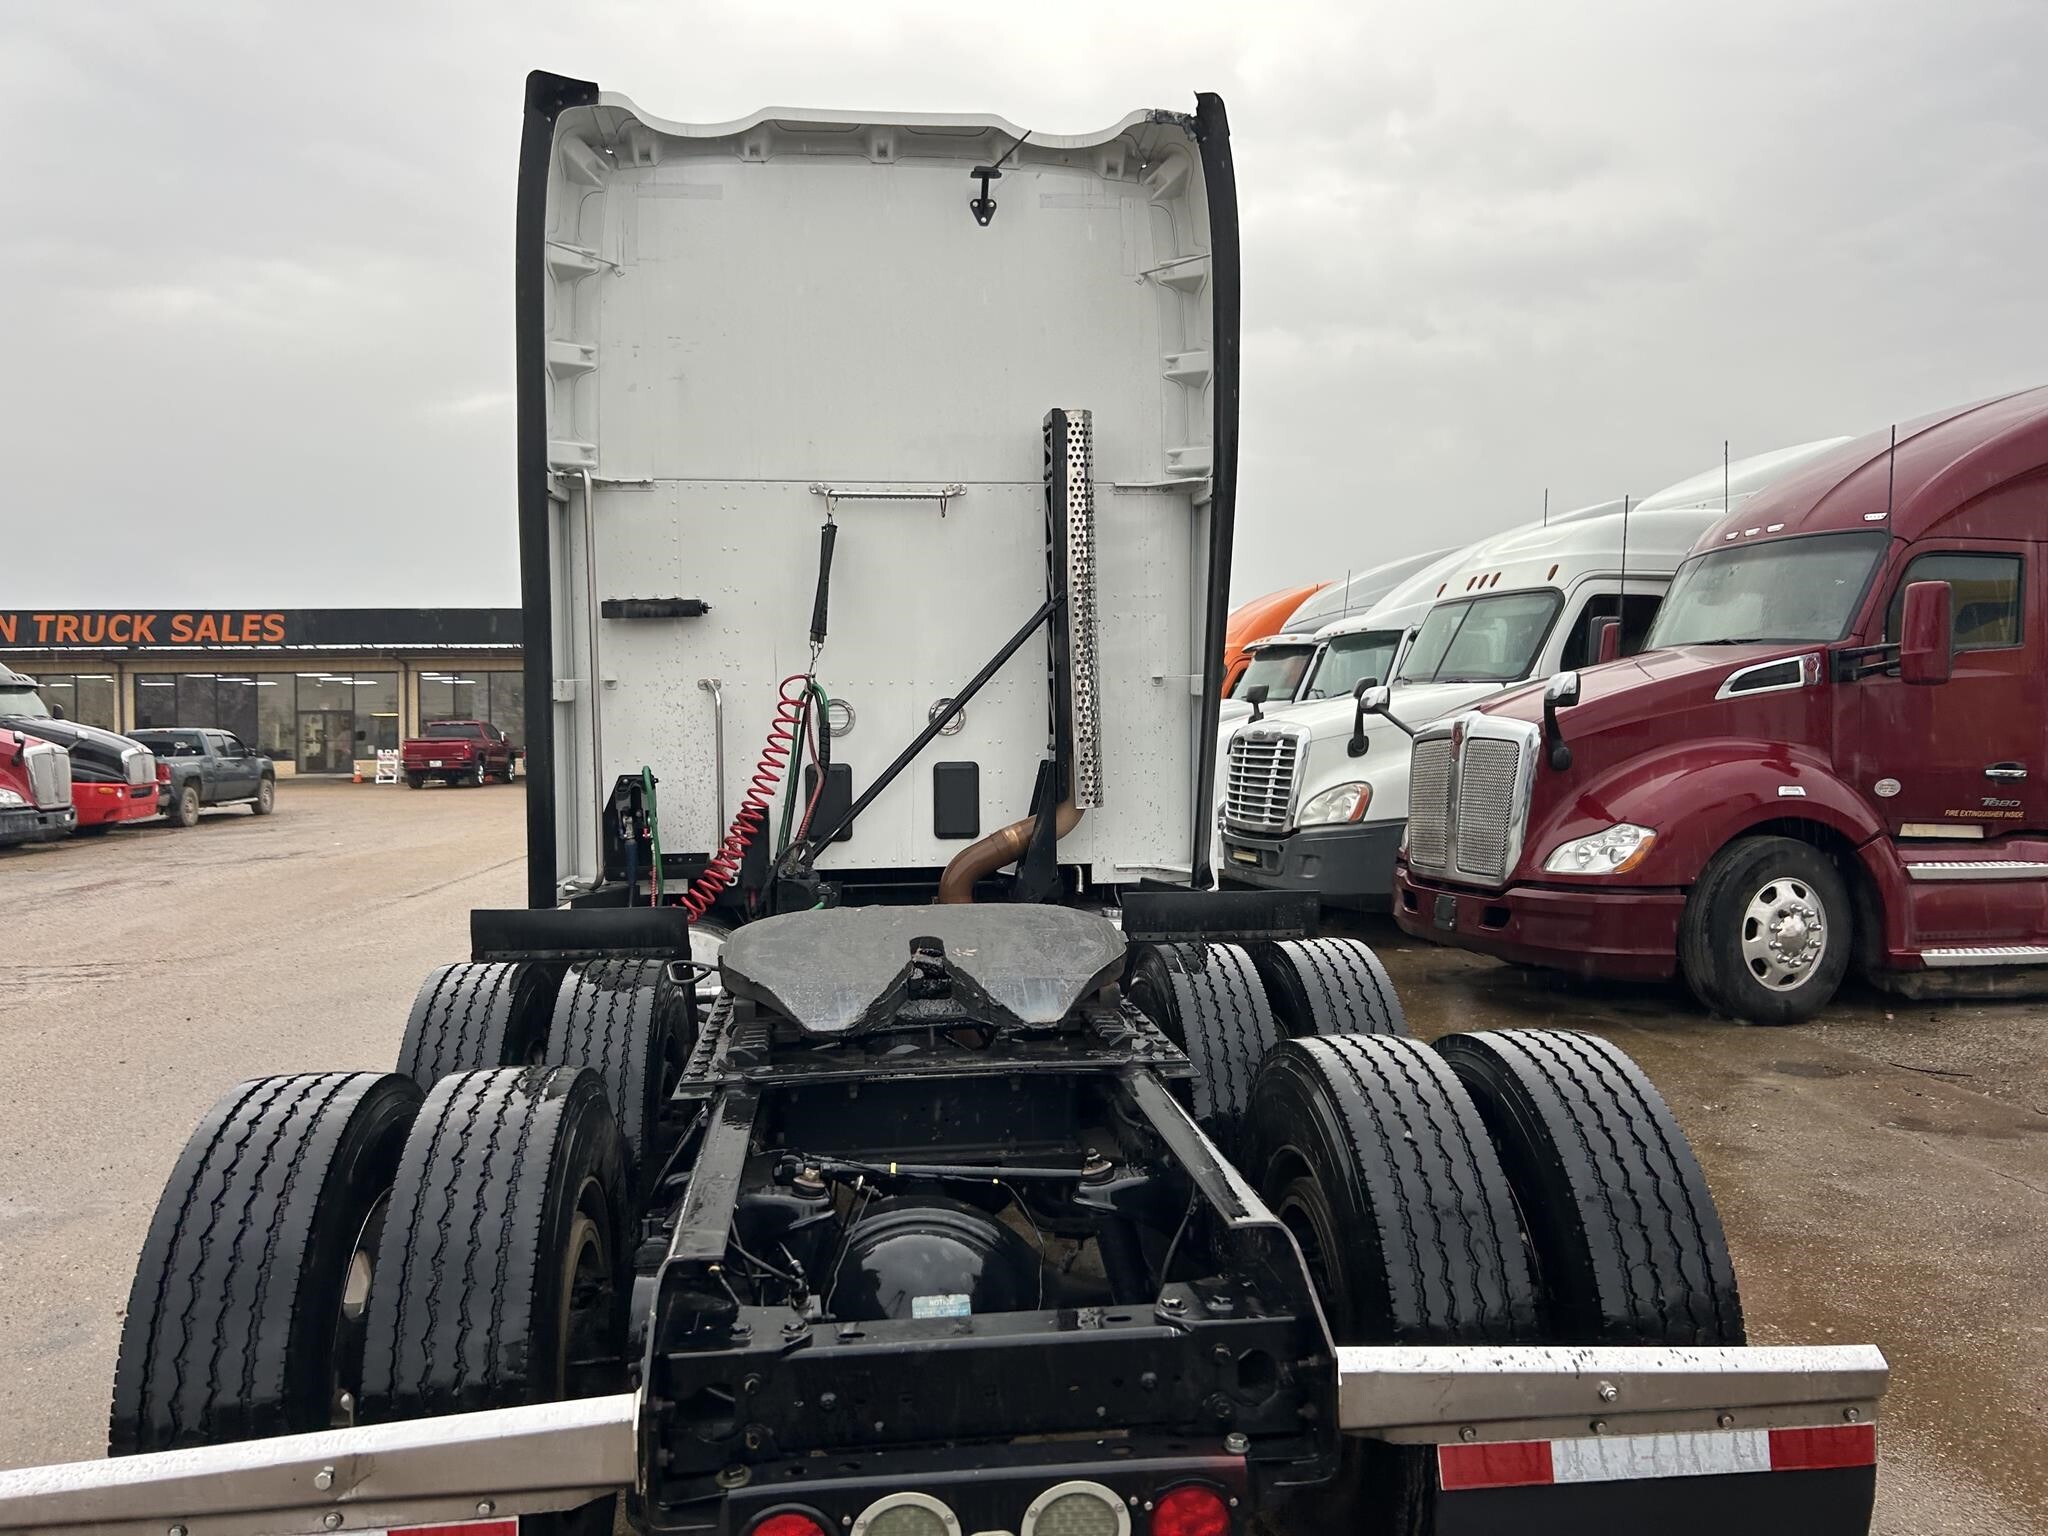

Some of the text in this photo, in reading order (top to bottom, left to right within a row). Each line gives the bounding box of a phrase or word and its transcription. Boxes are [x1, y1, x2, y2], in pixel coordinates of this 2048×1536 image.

[33, 614, 157, 643] TRUCK
[170, 614, 286, 642] SALES
[1981, 797, 2021, 807] T680
[1944, 809, 1959, 817] FIRE
[1960, 809, 2004, 818] EXTINGUISHER
